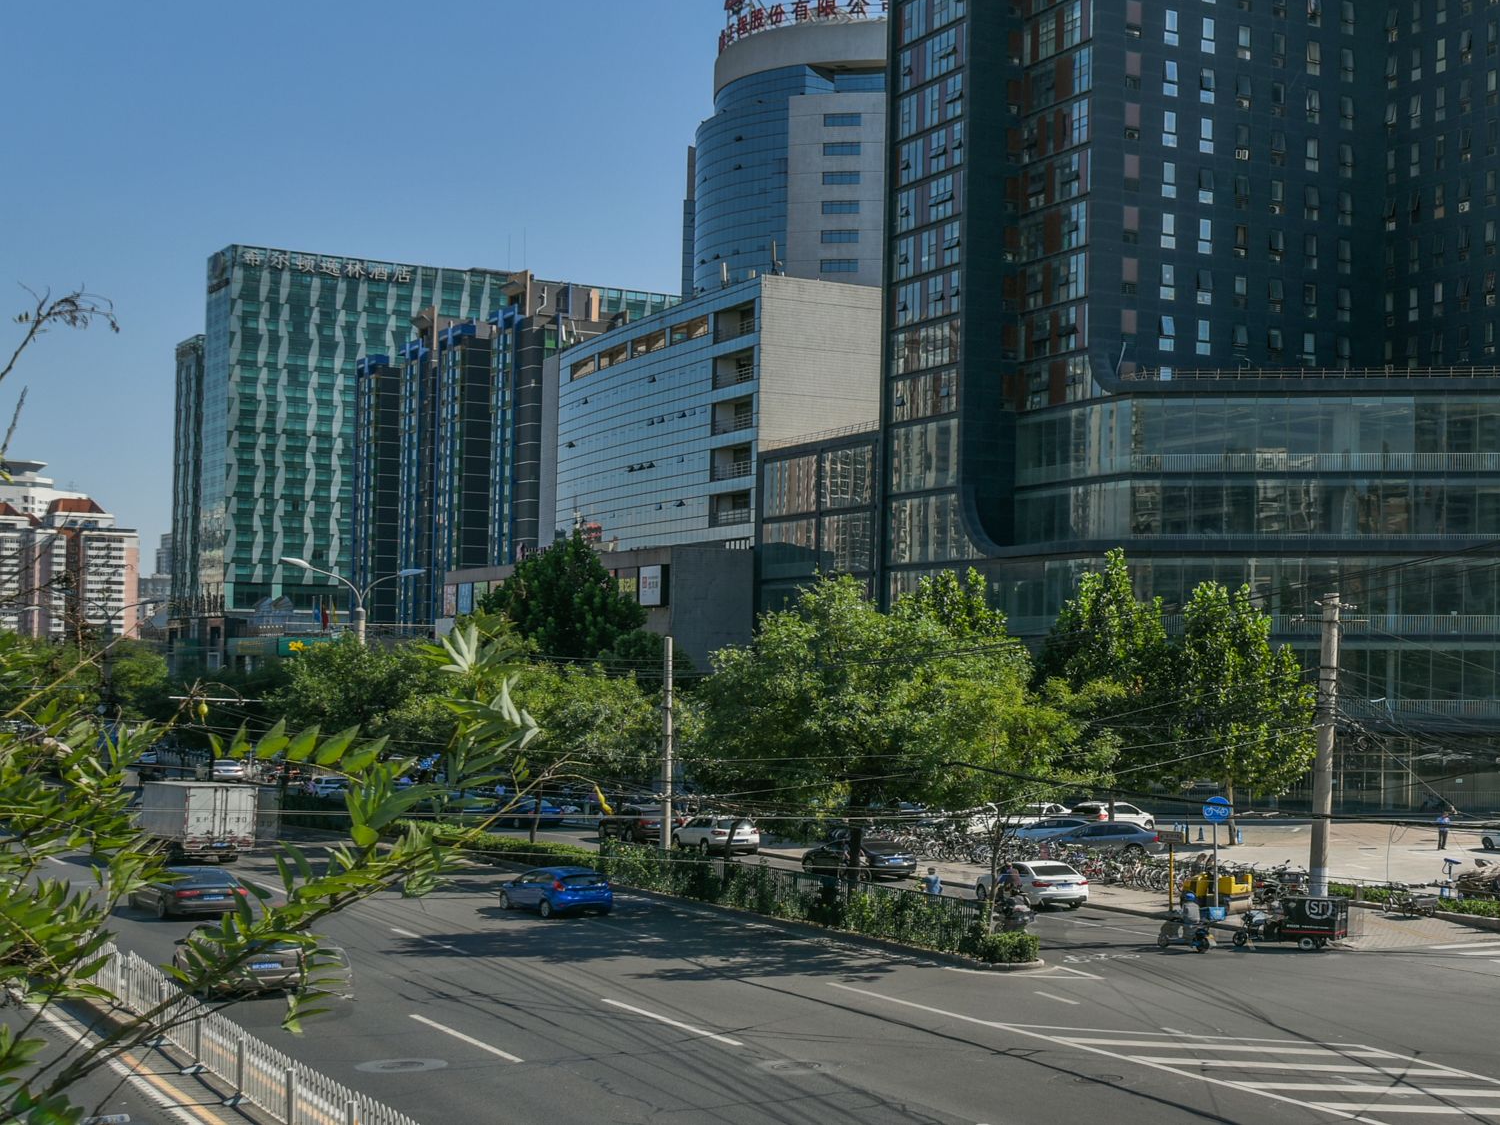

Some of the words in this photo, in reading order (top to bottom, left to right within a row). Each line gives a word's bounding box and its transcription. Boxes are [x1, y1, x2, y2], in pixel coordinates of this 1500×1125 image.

[242, 249, 413, 283] 希尔顿逸林酒店
